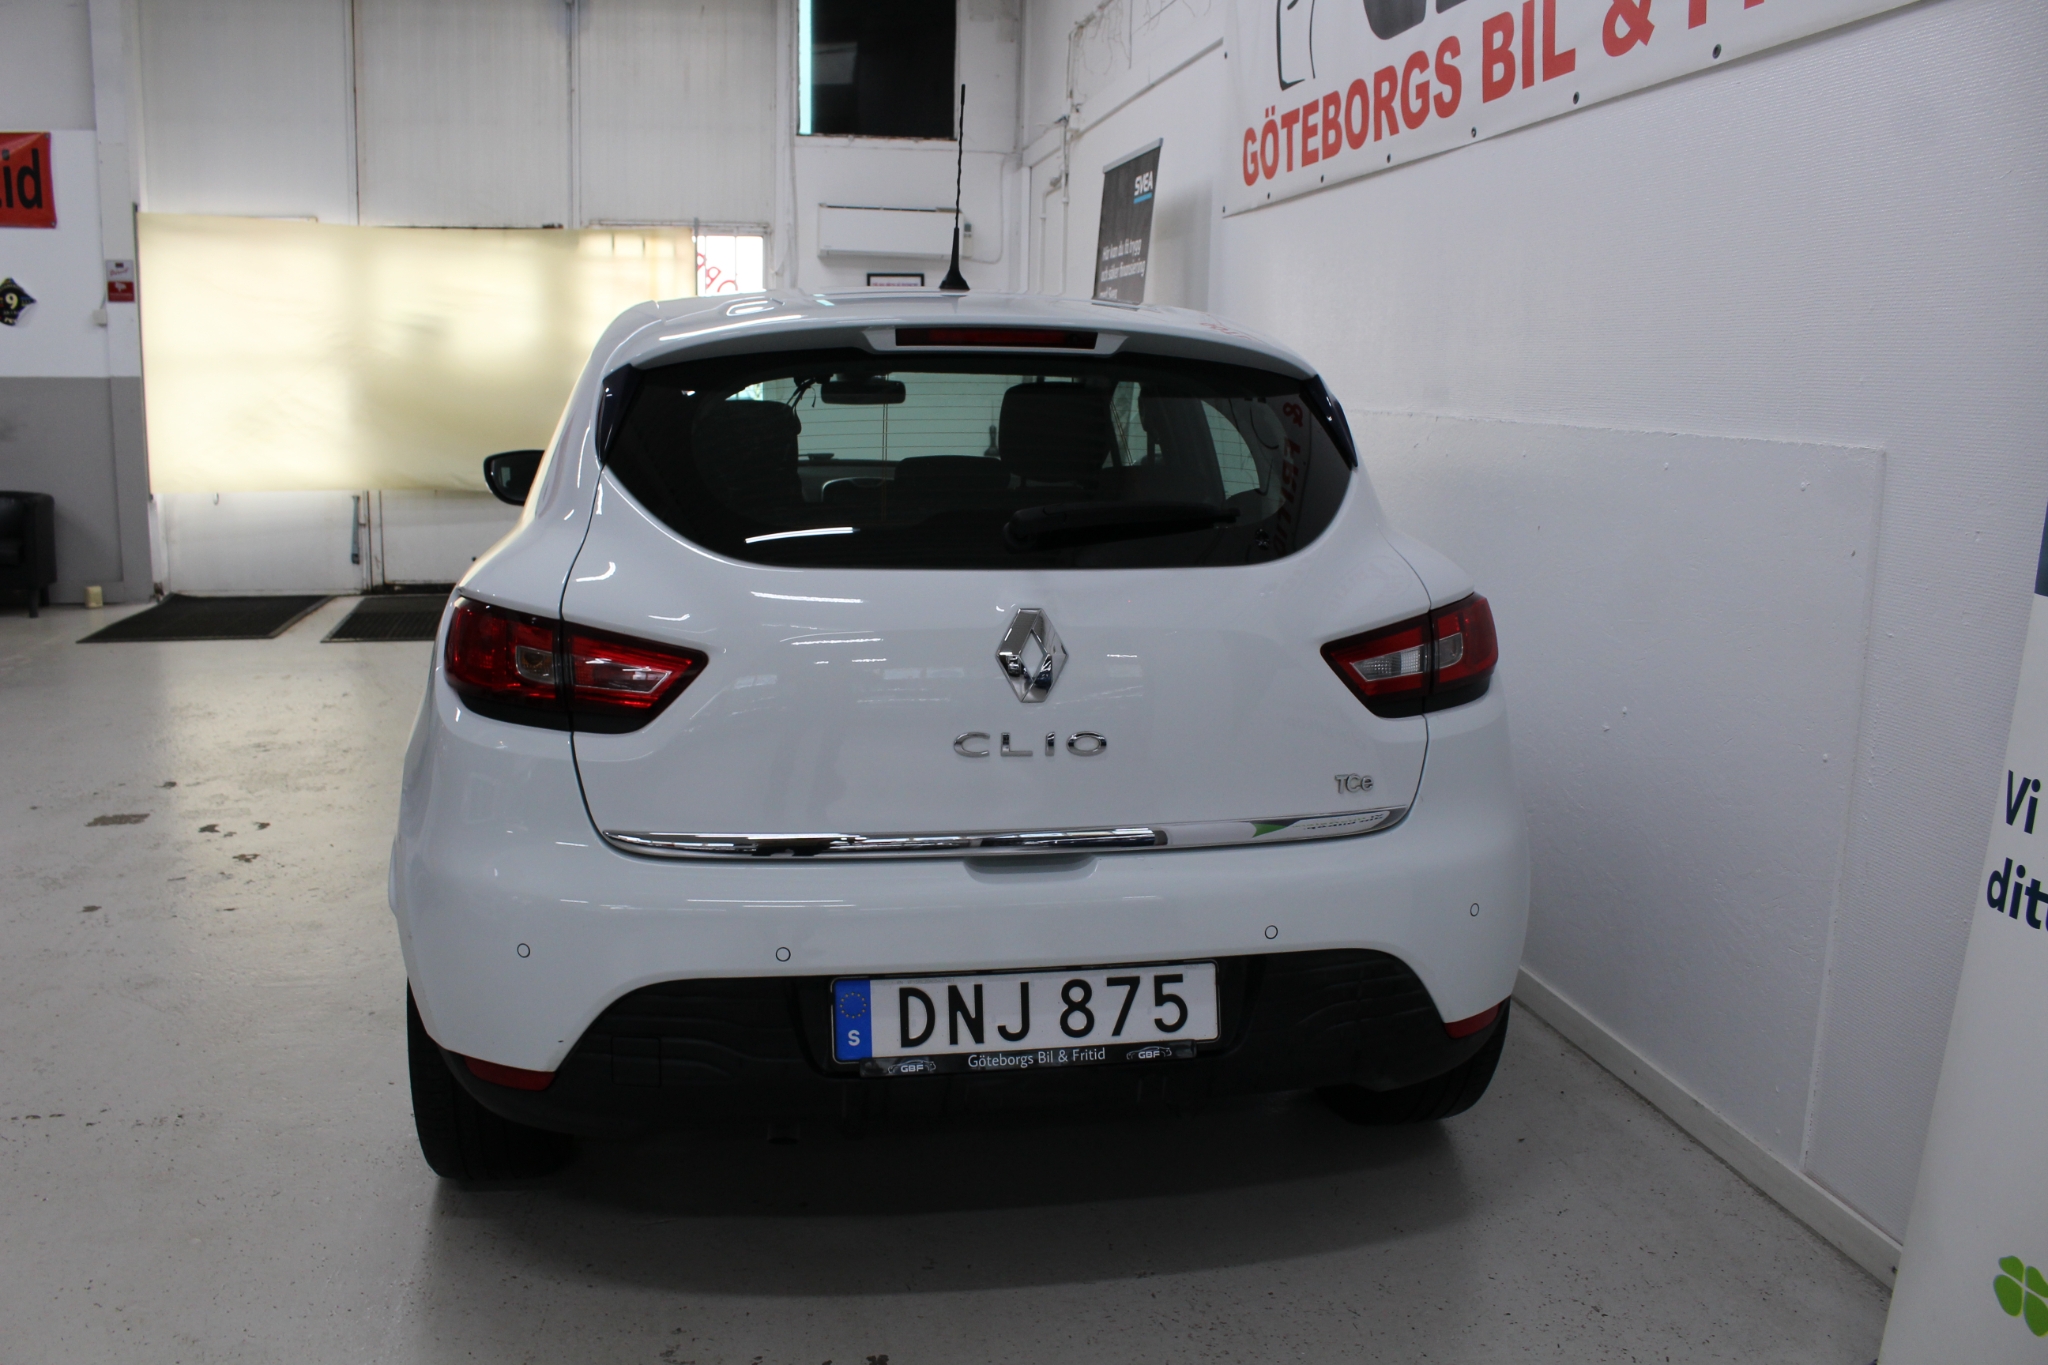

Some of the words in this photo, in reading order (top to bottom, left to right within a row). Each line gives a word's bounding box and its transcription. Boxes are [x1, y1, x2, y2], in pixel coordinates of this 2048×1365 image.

[1242, 36, 1462, 187] GÖTEBORGS
[1483, 0, 1576, 104] BIL
[0, 148, 43, 209] id
[1134, 171, 1153, 196] SVEA
[953, 730, 1108, 758] CLIO
[1335, 772, 1374, 794] TCe
[2006, 769, 2041, 835] Vi
[1987, 857, 2048, 932] dit
[899, 981, 1031, 1048] DNJ
[1059, 973, 1189, 1039] 875
[847, 1029, 861, 1047] S
[900, 1064, 924, 1073] GBF
[968, 1052, 1034, 1069] Göteborgs
[1038, 1050, 1054, 1064] Bil
[1058, 1049, 1069, 1063] &
[1072, 1047, 1106, 1062] Fritid
[1138, 1051, 1160, 1060] GBF
